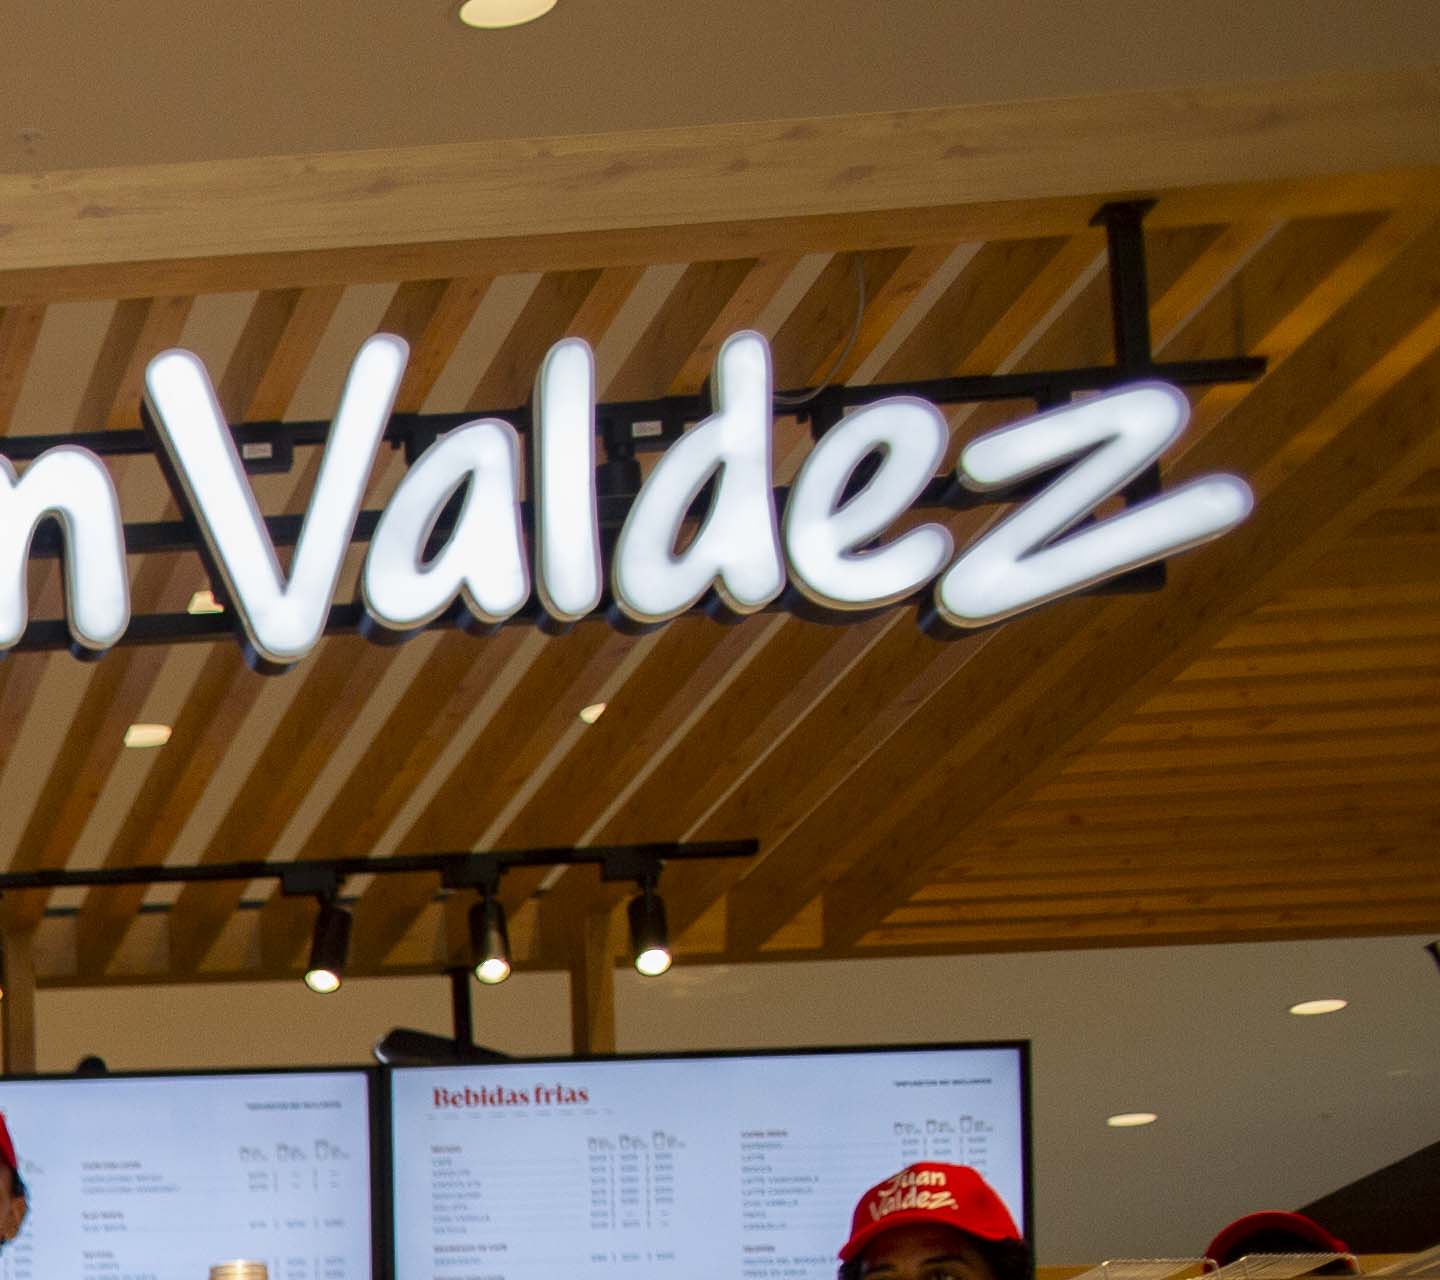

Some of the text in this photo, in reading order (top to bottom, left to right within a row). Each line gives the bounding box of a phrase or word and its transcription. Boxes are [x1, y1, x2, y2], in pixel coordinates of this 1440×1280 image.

[145, 331, 1253, 663] Valdez
[434, 1086, 530, 1109] Bebidas
[878, 1170, 947, 1198] Juan
[869, 1187, 956, 1222] Valdez
